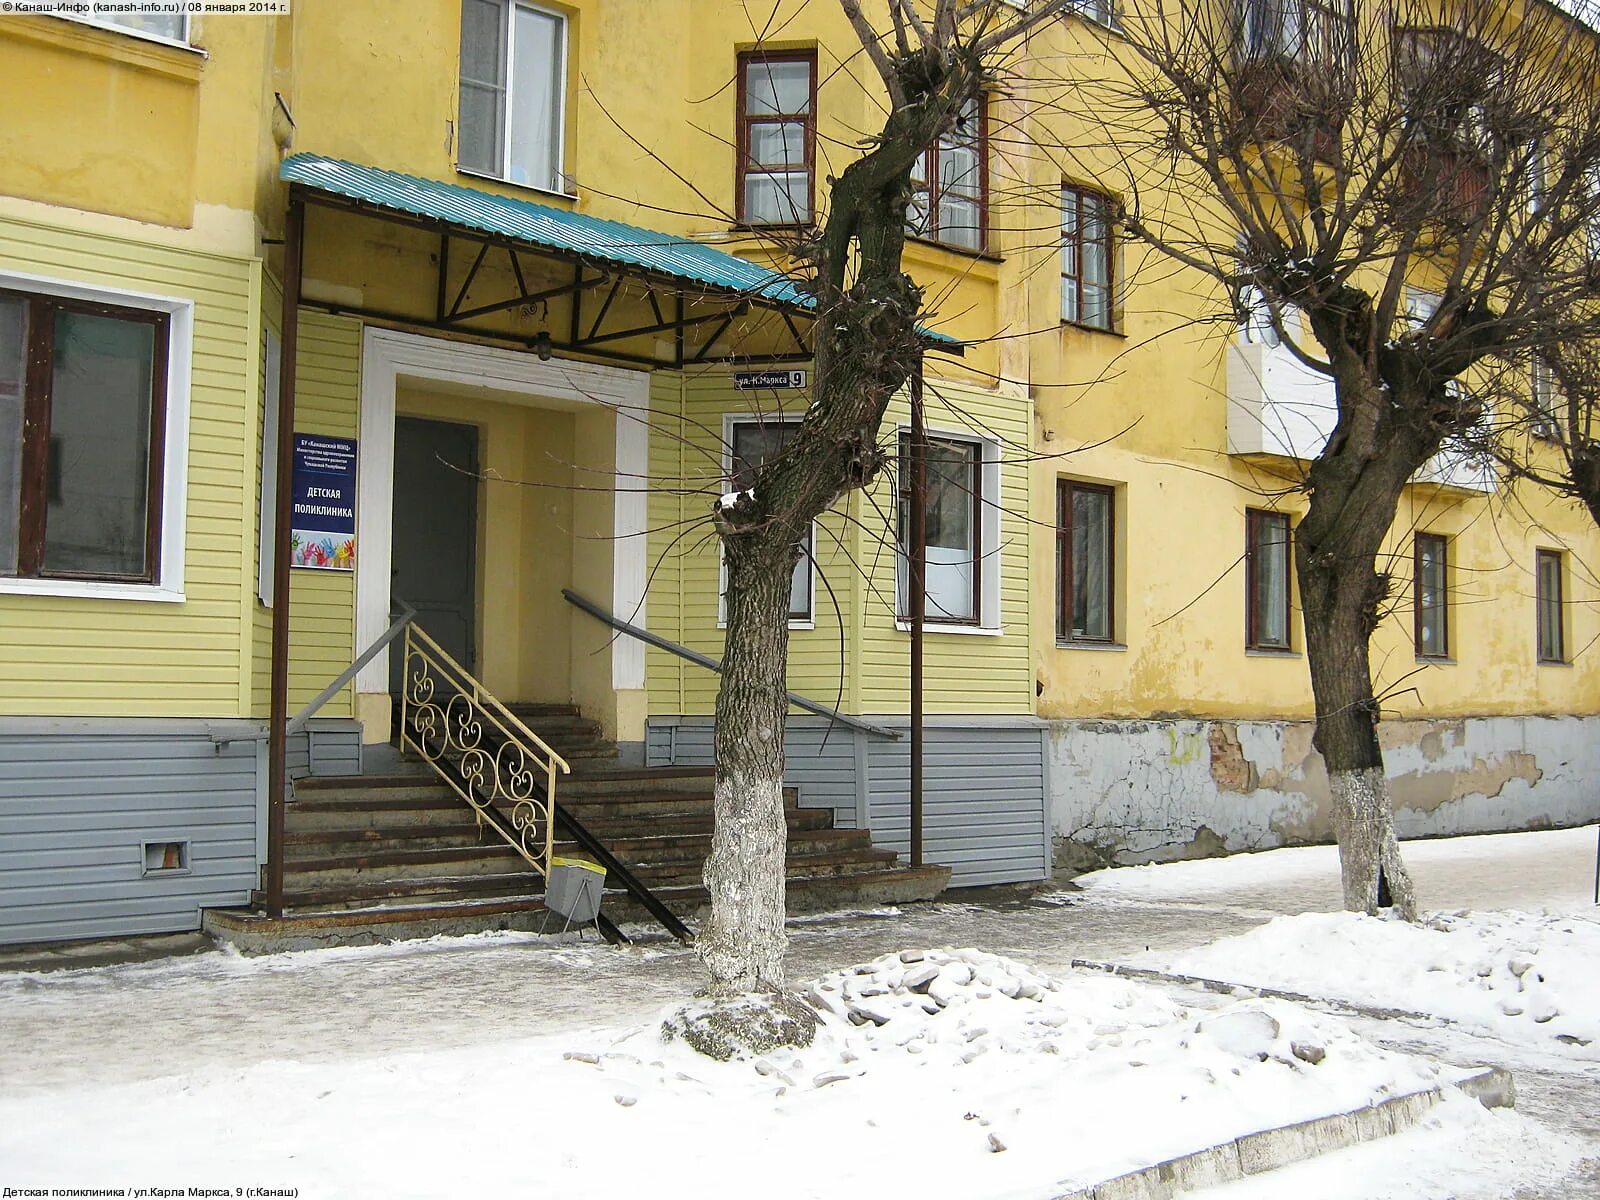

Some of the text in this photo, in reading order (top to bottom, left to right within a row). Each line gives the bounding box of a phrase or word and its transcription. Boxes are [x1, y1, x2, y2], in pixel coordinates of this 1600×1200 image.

[793, 372, 802, 386] 9
[306, 486, 341, 499] ДЕТСКАЯ
[294, 503, 353, 518] ПОЛИКЛИНИКА
